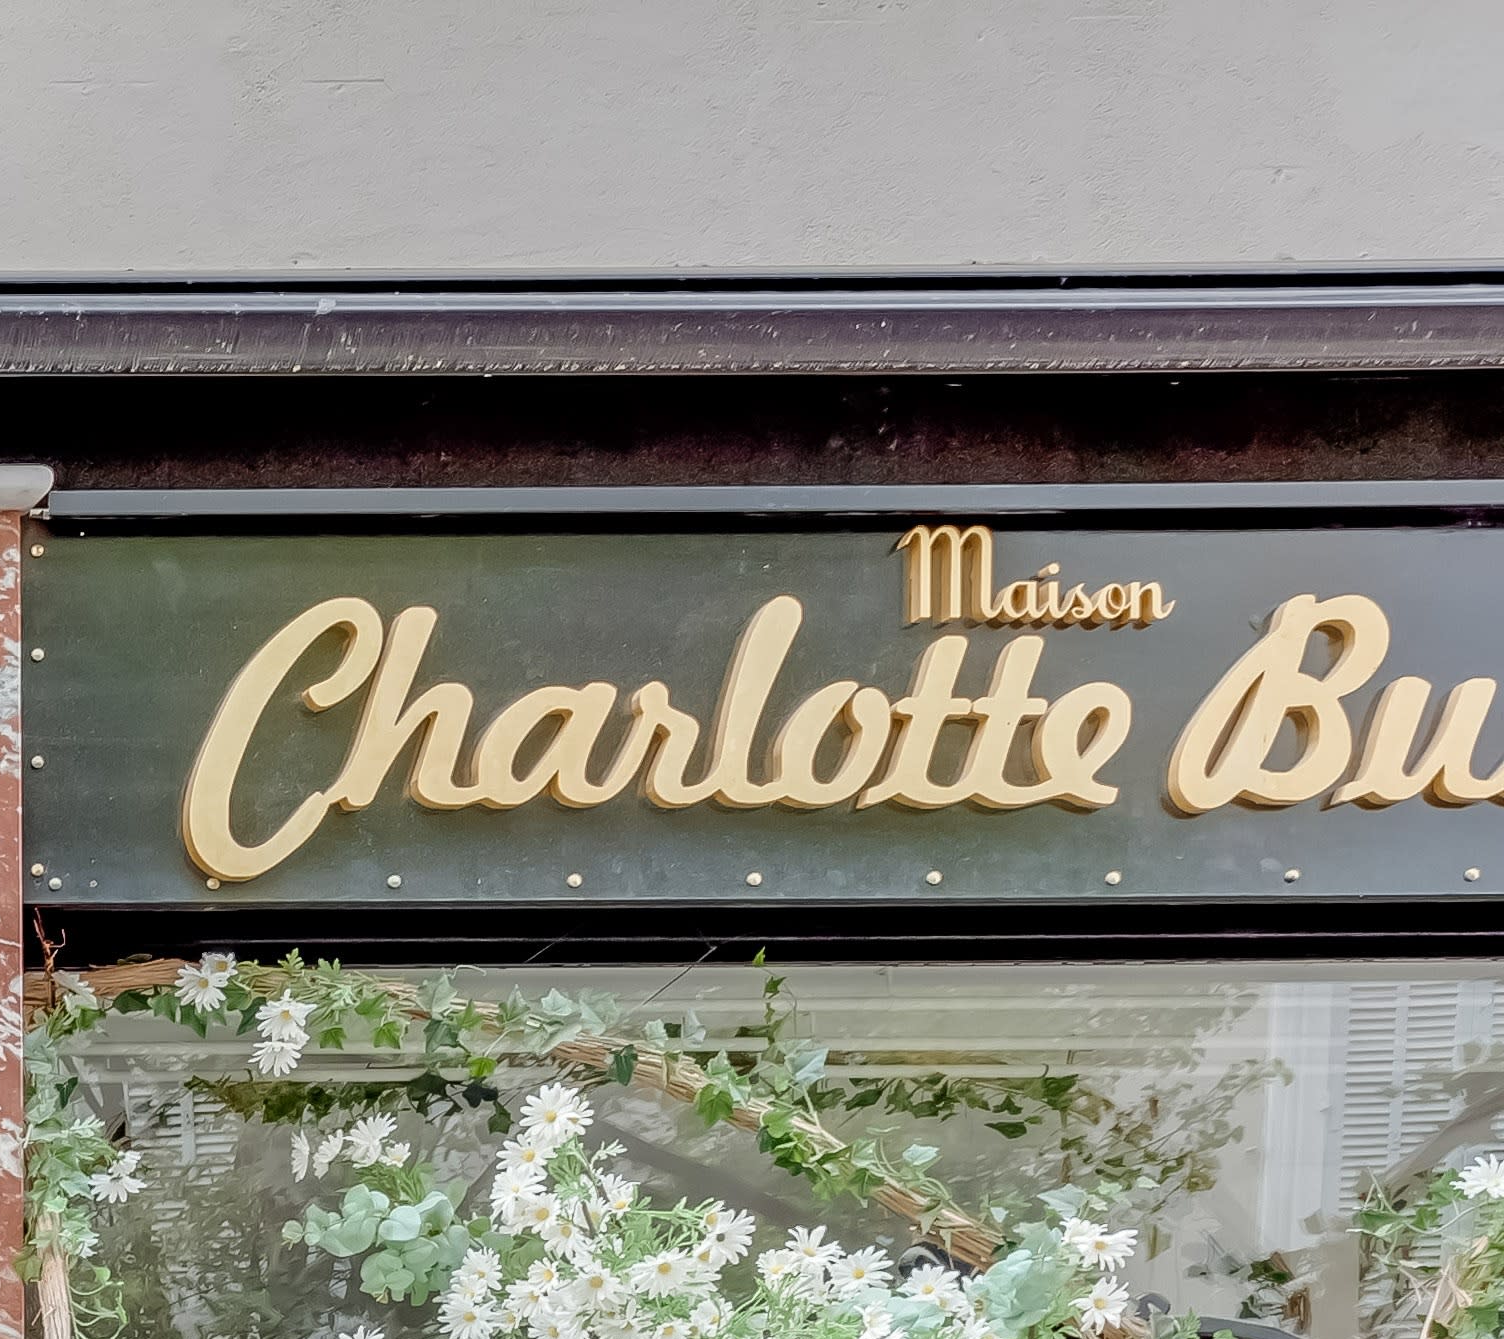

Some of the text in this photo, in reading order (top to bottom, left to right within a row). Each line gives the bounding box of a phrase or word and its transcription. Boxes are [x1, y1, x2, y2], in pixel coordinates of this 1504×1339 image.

[898, 523, 1174, 629] Maison
[181, 593, 1504, 882] Charlotte Bu
